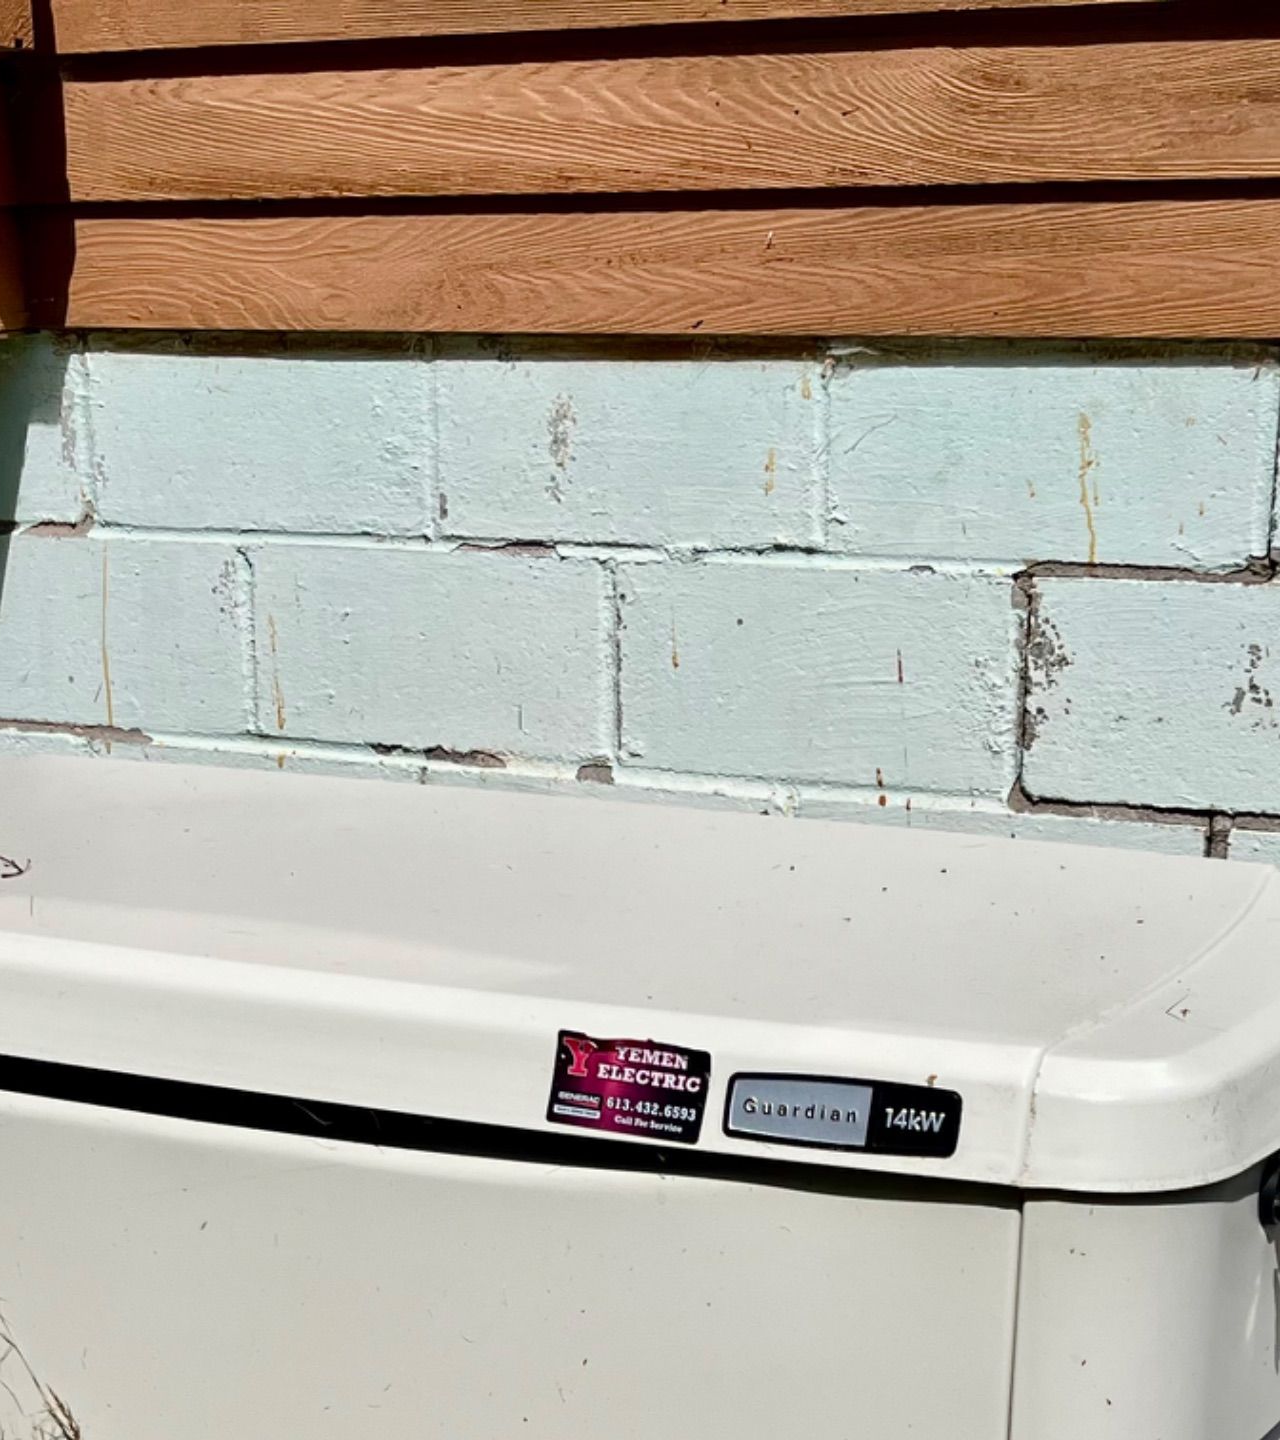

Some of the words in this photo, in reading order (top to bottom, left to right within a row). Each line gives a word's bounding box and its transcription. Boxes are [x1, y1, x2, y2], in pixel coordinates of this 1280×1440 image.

[615, 1046, 689, 1071] YEMEN
[597, 1063, 701, 1092] ELECTRIC
[606, 1096, 697, 1122] 613.432.6593
[743, 1097, 857, 1124] Guardian
[883, 1107, 945, 1133] 14kW
[614, 1115, 633, 1127] Call
[649, 1120, 683, 1134] Service
